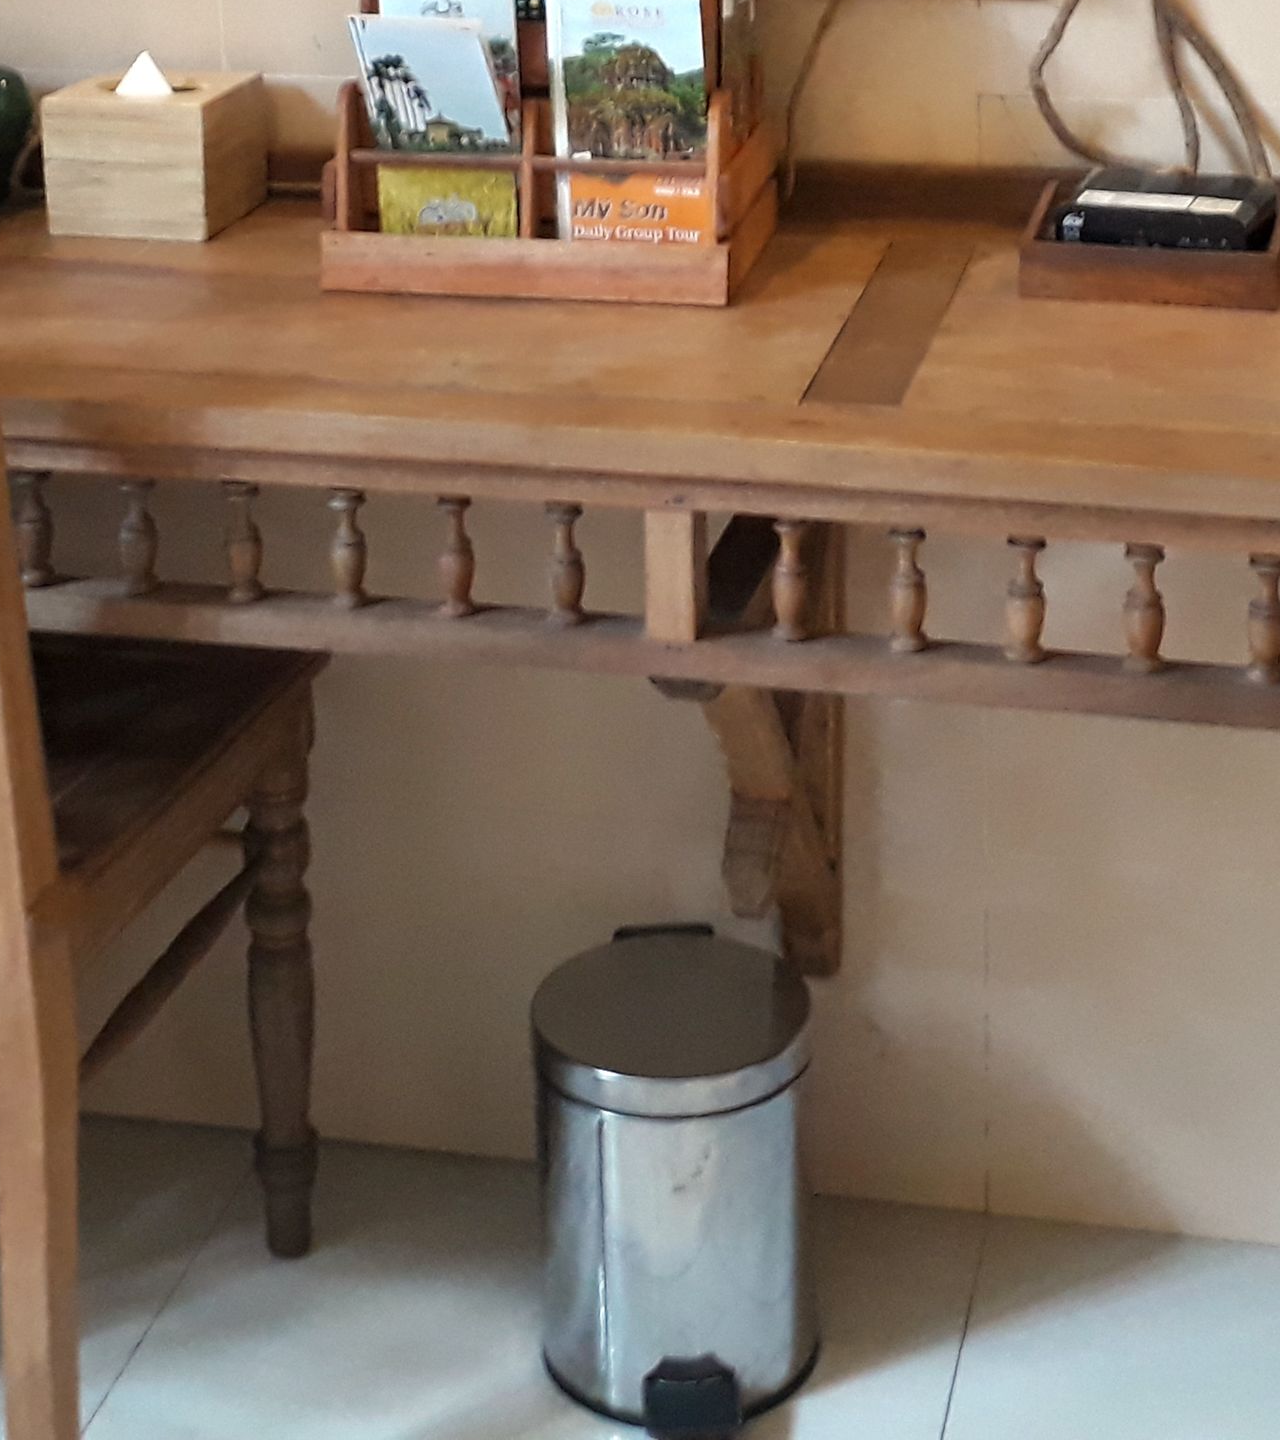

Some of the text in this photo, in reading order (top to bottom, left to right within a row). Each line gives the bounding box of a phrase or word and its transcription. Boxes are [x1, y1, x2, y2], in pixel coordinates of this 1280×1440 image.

[573, 223, 701, 244] Daily Group Tour
